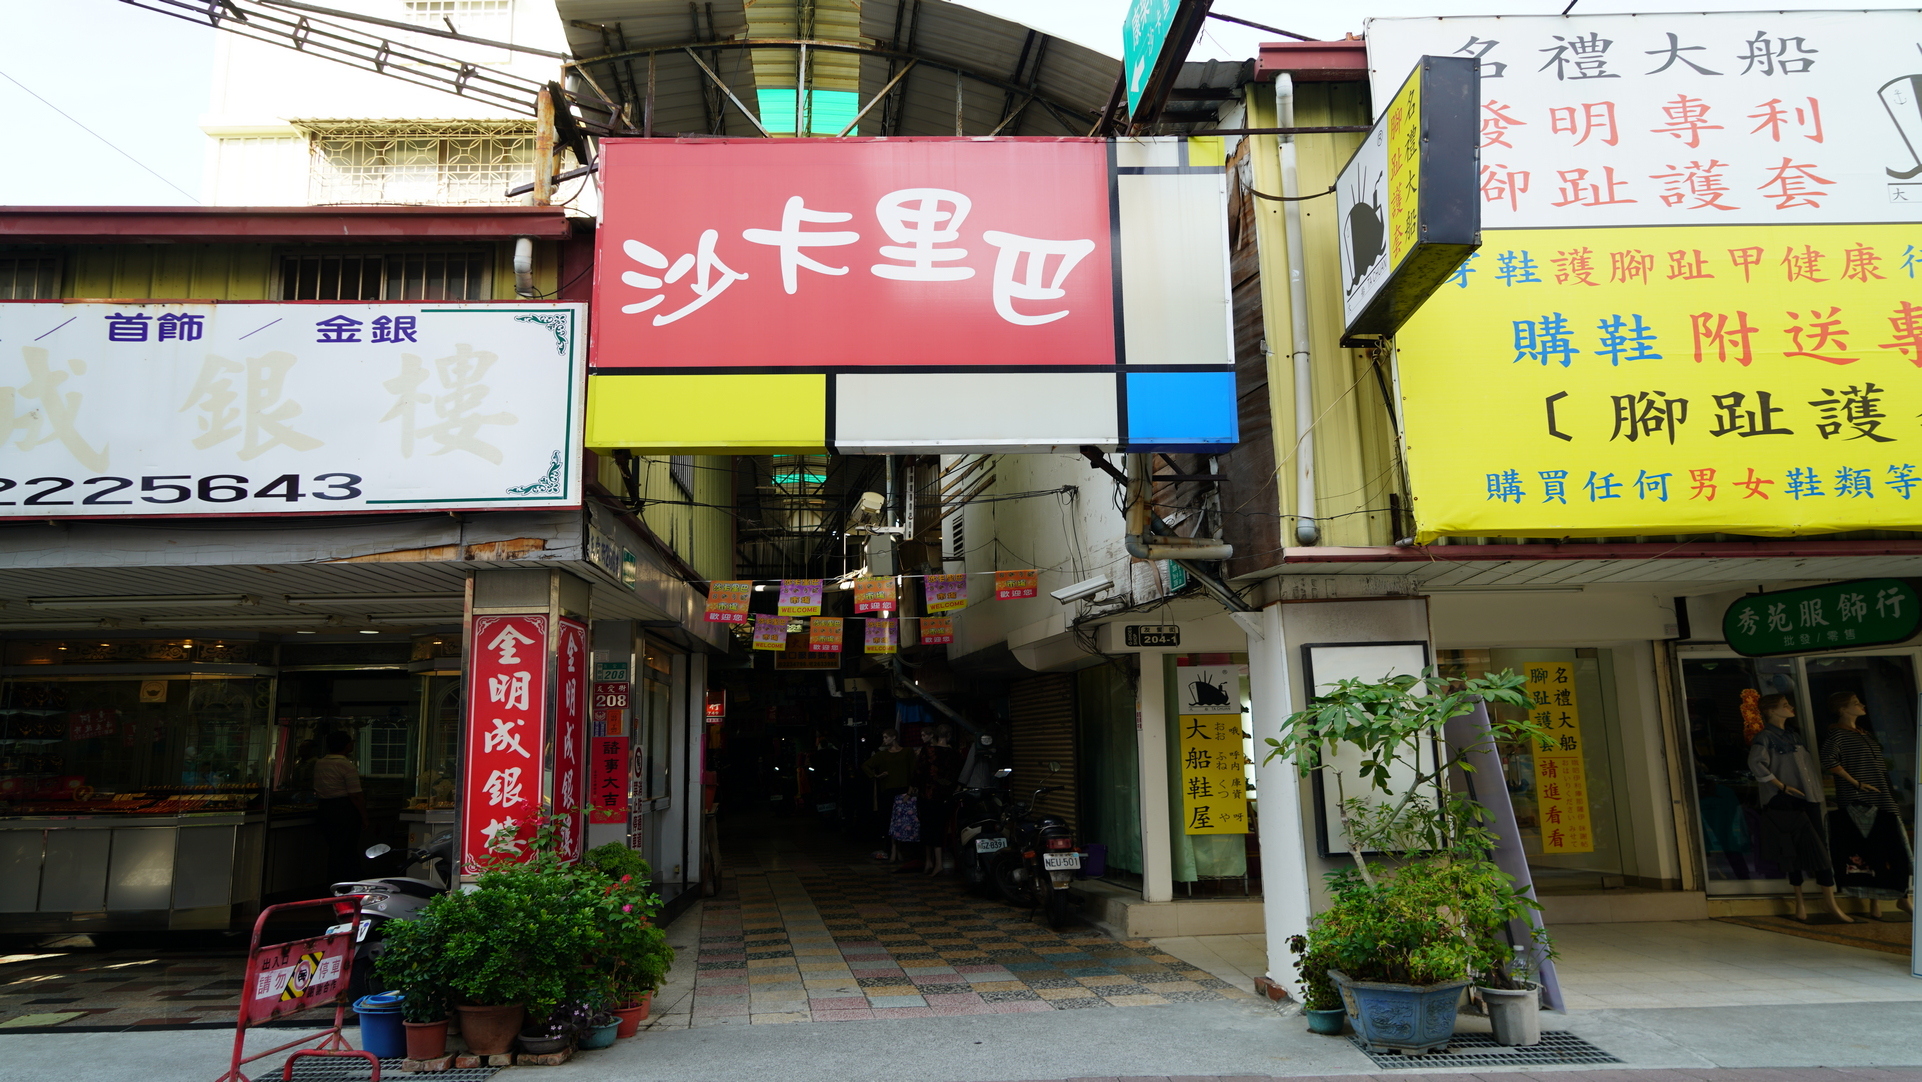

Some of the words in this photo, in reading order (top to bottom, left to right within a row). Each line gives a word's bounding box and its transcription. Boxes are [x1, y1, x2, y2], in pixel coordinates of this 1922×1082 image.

[1452, 30, 1819, 81] 名禮大船
[1480, 94, 1825, 150] 發明專利
[1404, 89, 1418, 244] 名禮大船
[1390, 106, 1403, 259] 腳趾護套
[621, 188, 1095, 326] 沙卡里巴
[105, 312, 205, 342] 首飾
[315, 315, 418, 343] 金銀
[1486, 465, 1922, 504] 購買任何男女鞋類等
[936, 592, 957, 600] 市場
[1000, 589, 1033, 598] 歡迎您
[1005, 579, 1027, 588] 市場
[717, 602, 738, 611] 市場
[790, 596, 811, 604] 市場
[859, 601, 892, 610] 歡迎您
[930, 601, 964, 610] WELCOME
[1737, 587, 1906, 636] 秀苑服飾行
[709, 613, 743, 621] 歡迎您
[1144, 635, 1178, 644] 204-1
[604, 670, 625, 679] 208
[595, 694, 627, 707] 208
[1552, 667, 1578, 751] 名禮大船
[601, 740, 621, 807] 諸事大吉
[1185, 718, 1214, 829] 大船鞋屋
[1539, 760, 1565, 848] 請進看看
[258, 972, 286, 995] 請勿
[319, 959, 341, 979] 停車
[262, 955, 289, 971] 出入口
[307, 980, 337, 998] 謝謝合作
